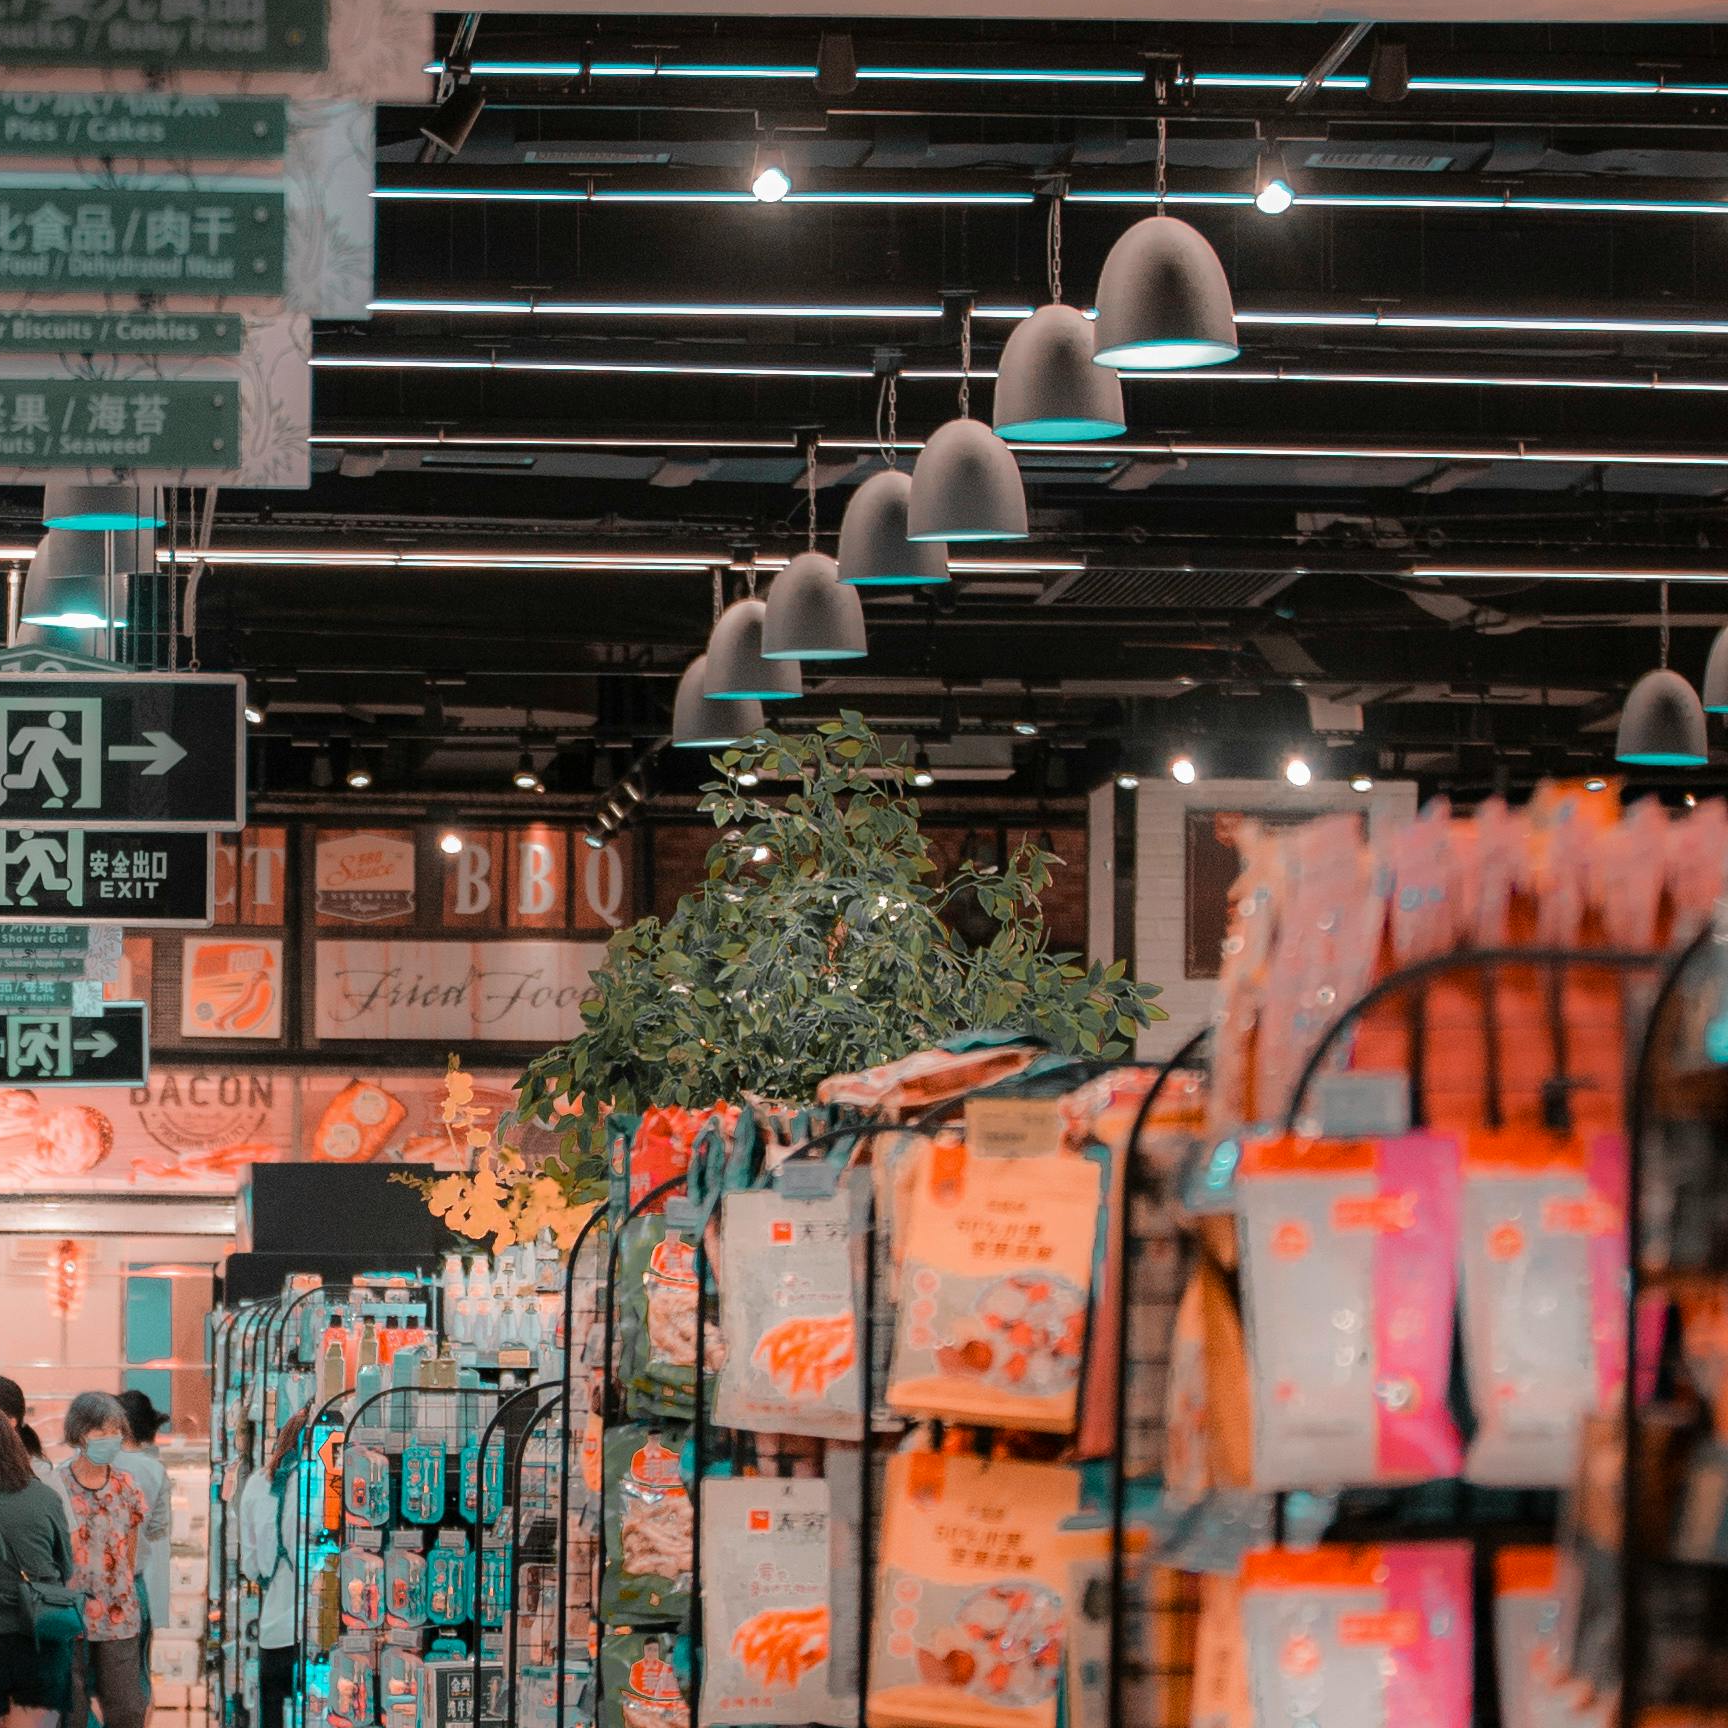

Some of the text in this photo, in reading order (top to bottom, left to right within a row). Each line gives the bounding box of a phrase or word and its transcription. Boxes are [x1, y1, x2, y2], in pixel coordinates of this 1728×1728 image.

[5, 117, 58, 142] Pies
[87, 118, 166, 143] Cakes
[0, 255, 49, 275] Food
[13, 319, 93, 340] Biscuits
[116, 320, 199, 341] Cookies
[59, 435, 152, 455] Seaweed
[89, 849, 168, 879] 安全出口
[99, 881, 159, 899] EXIT
[454, 841, 624, 927] BBQ
[1, 934, 45, 944] Shower
[49, 933, 68, 944] Gel
[4, 959, 33, 969] Sanitary
[34, 960, 65, 970] Napkins
[0, 994, 27, 1002] Toilet
[30, 994, 55, 1002] Rolls
[328, 964, 474, 1023] Fried
[129, 1075, 273, 1108] BACON
